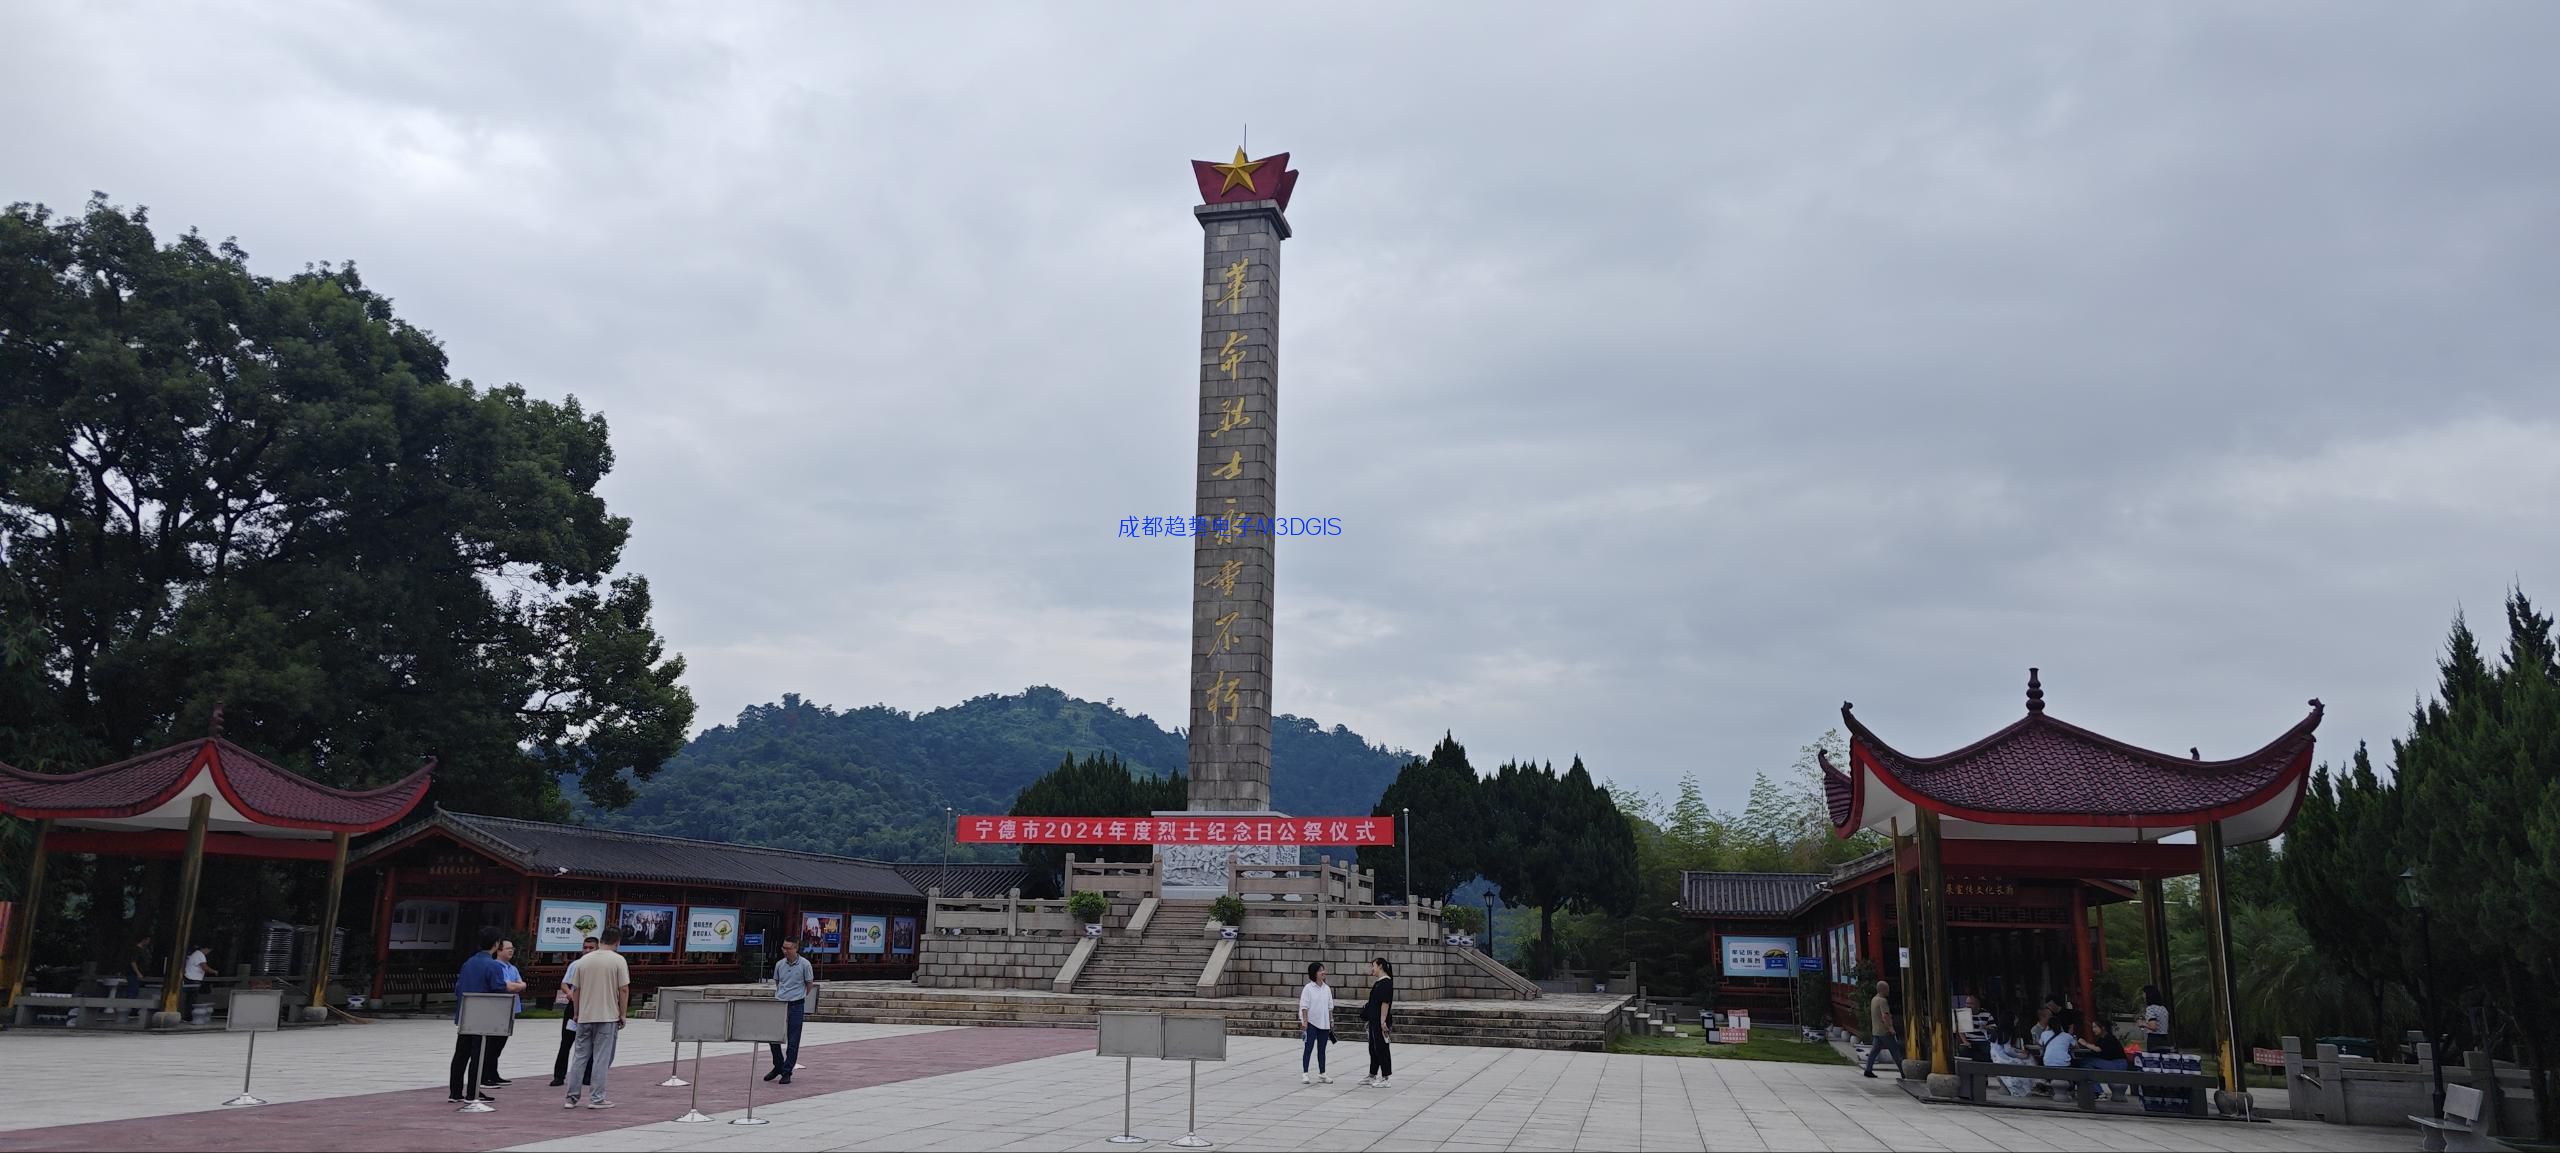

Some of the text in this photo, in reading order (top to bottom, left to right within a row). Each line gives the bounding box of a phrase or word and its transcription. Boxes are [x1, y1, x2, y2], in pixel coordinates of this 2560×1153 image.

[1203, 257, 1251, 722] 革命烈士永垂不朽
[975, 819, 1377, 843] 宁德市2024年度烈士纪念日公祭仪式
